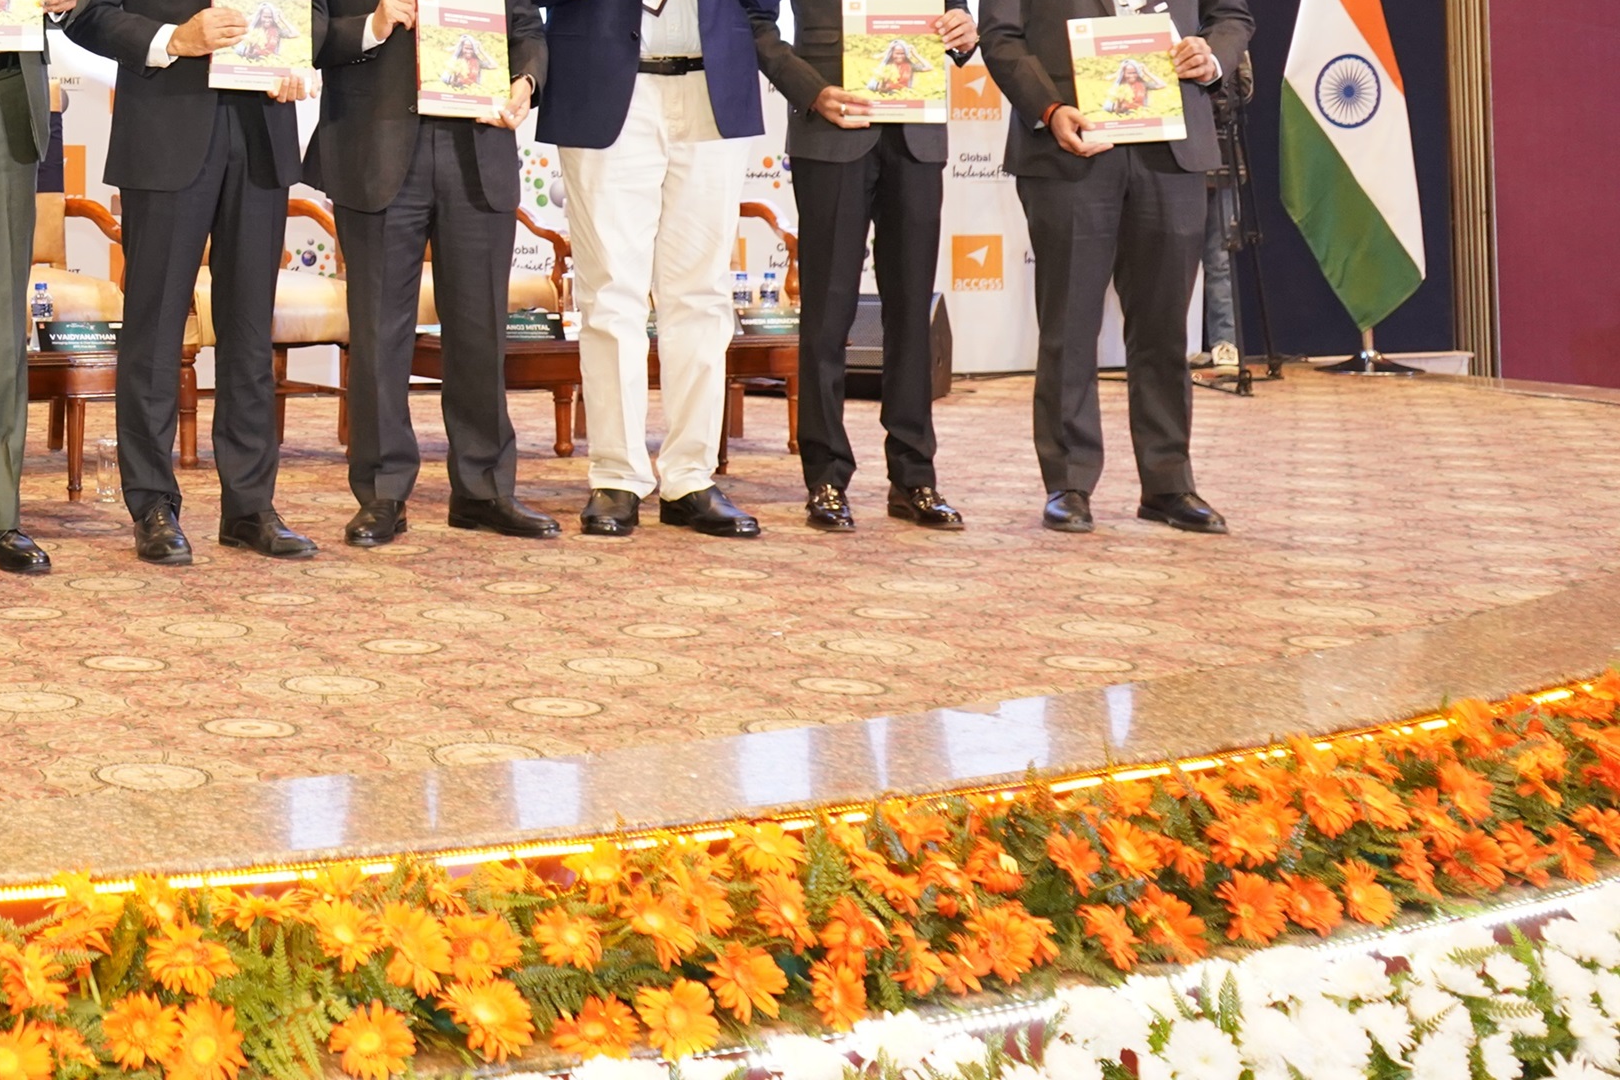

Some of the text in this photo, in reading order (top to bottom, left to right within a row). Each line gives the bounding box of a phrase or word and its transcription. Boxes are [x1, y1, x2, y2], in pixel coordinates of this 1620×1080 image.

[952, 107, 1001, 120] access
[959, 152, 991, 162] Global
[514, 245, 538, 255] obal
[954, 278, 1003, 291] access
